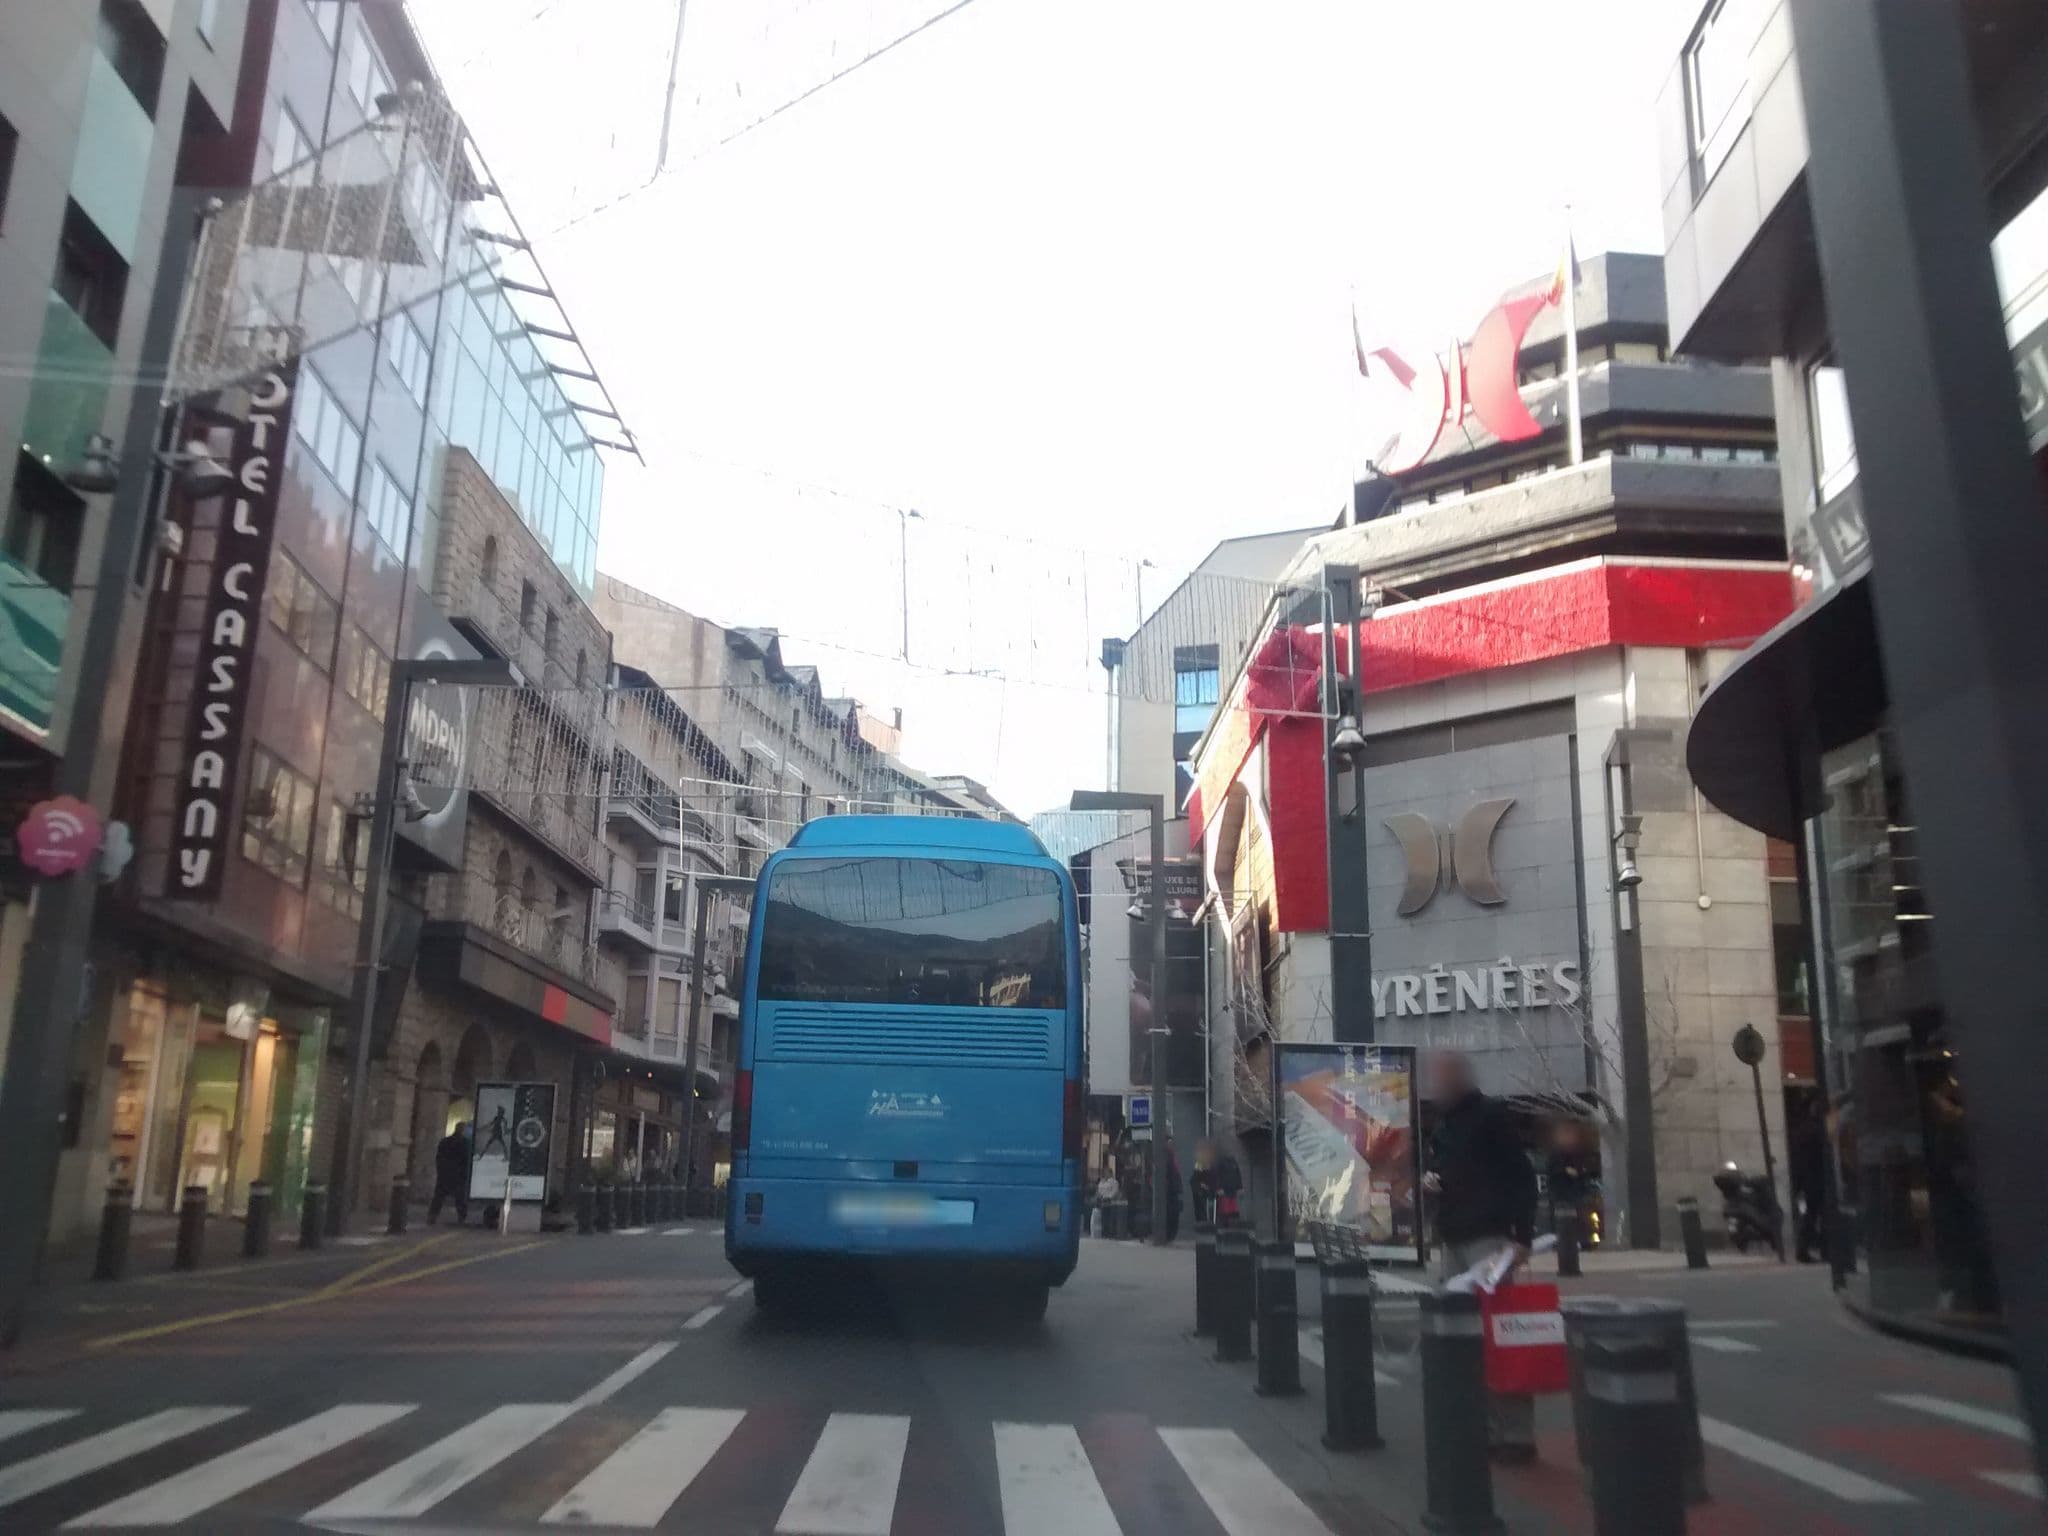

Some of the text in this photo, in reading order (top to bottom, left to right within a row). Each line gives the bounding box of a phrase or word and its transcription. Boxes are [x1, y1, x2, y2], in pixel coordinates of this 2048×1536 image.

[180, 330, 290, 888] HOTEL CASSANY
[410, 696, 461, 768] MDRN
[1371, 956, 1581, 1018] YRÉNÉES
